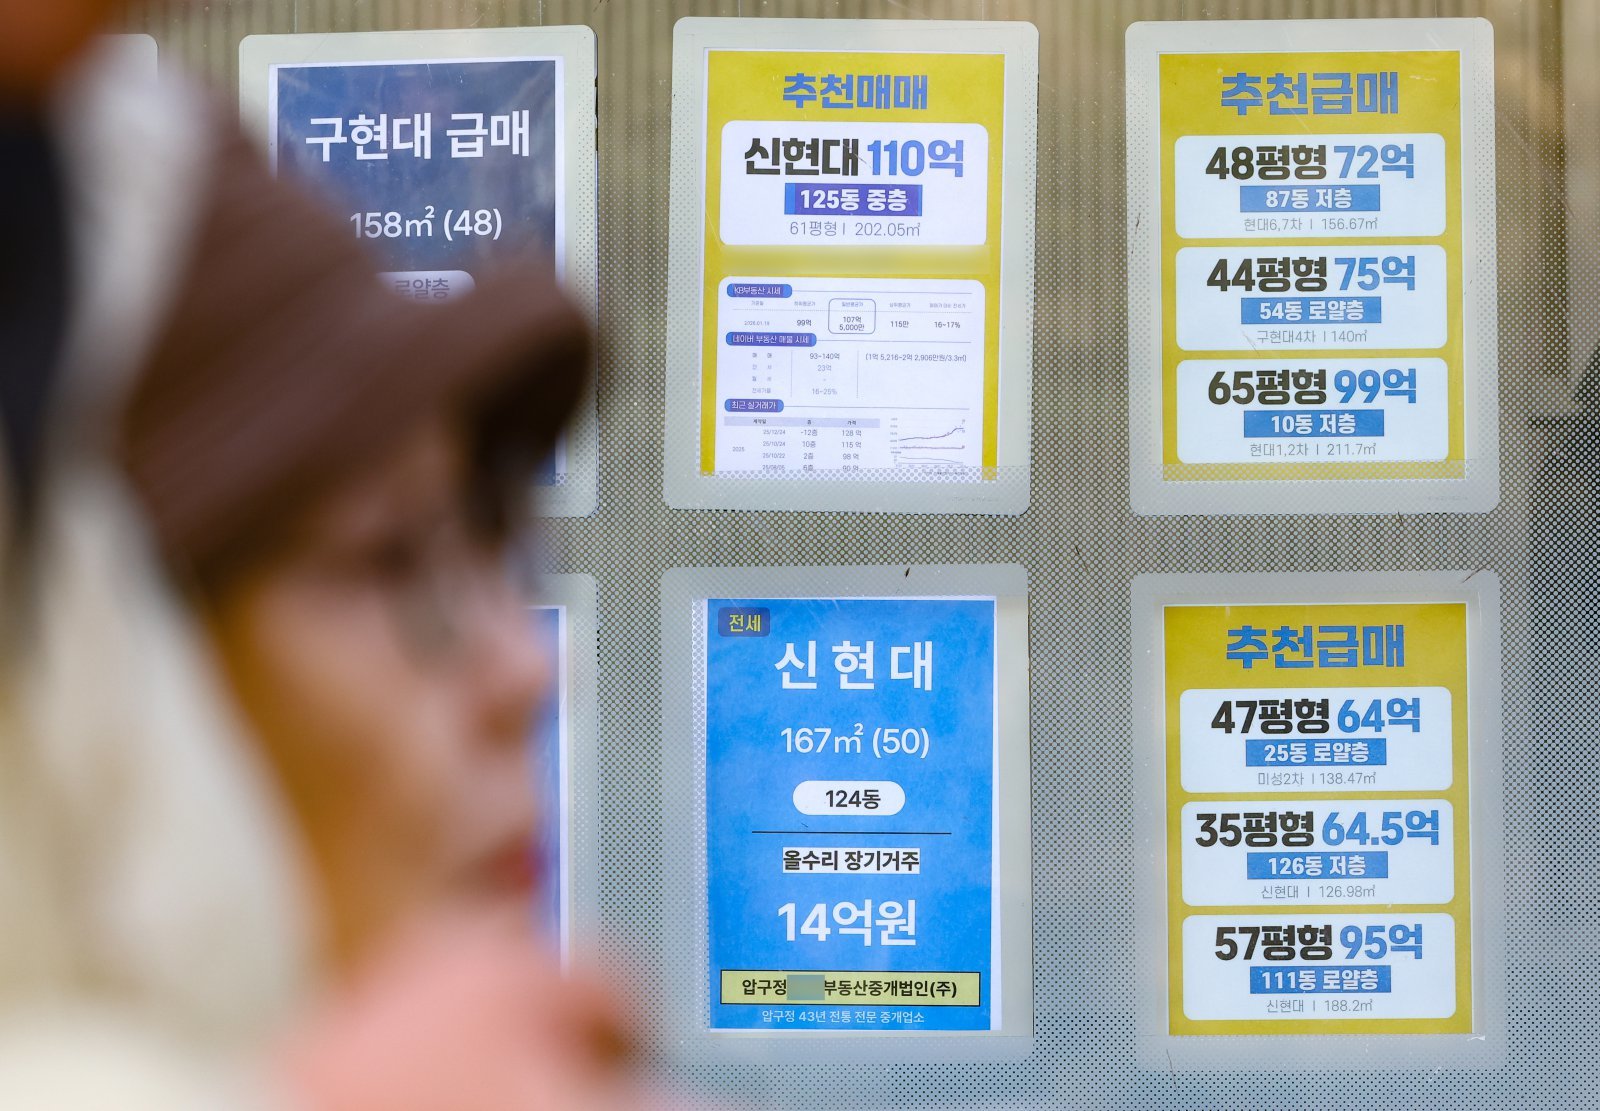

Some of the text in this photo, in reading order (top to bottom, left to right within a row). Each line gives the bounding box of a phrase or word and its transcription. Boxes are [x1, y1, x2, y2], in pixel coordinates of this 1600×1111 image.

[783, 72, 927, 109] 추천매매
[1221, 71, 1399, 115] 추천급매
[305, 110, 531, 162] 구현대 급매
[744, 137, 964, 177] 신현대 110억
[1205, 143, 1414, 180] 48평형 72억
[800, 189, 908, 212] 125동 중층
[1265, 188, 1352, 209] 87동 저층
[444, 208, 502, 241] (48)
[790, 220, 921, 237] 61평형 202.05㎡
[1244, 217, 1379, 232] 현대6,7차 156.67㎡
[1206, 255, 1415, 293] 44평형 75억
[767, 287, 780, 295] 시세
[1259, 300, 1364, 321] 54동 로얄층
[890, 320, 909, 328] 115만
[732, 334, 753, 343] 네이버
[756, 334, 777, 344] 부동산
[795, 335, 810, 344] 시세
[1257, 329, 1368, 344] 구현대4차 140㎡
[1208, 368, 1417, 405] 65평형 99억
[731, 401, 776, 410] 최근 실거래가
[1271, 413, 1356, 434] 10동 저층
[1249, 442, 1377, 457] 현대1,2차 211.7㎡
[729, 614, 761, 632] 전세
[1226, 624, 1405, 669] 추천급매
[1211, 697, 1421, 734] 47평형 64억
[780, 722, 930, 759] 167㎡ (50)
[1264, 742, 1369, 763] 25동 로얄층
[1258, 772, 1377, 786] 미성2차 138.47㎡
[825, 789, 881, 810] 124동
[1195, 809, 1439, 848] 35평형 64.5억
[783, 850, 920, 872] 올수리 장기거주
[1268, 855, 1366, 877] 126동 저층
[1261, 884, 1376, 900] 신현대 126.98㎡
[777, 899, 917, 947] 14억원
[1214, 923, 1423, 961] 57평형 95억
[1261, 969, 1379, 991] 111동 로얄층
[1267, 998, 1373, 1013] 신현대 188.2㎡
[762, 1010, 925, 1024] 압구정 43년 전통 전문 중개업소
